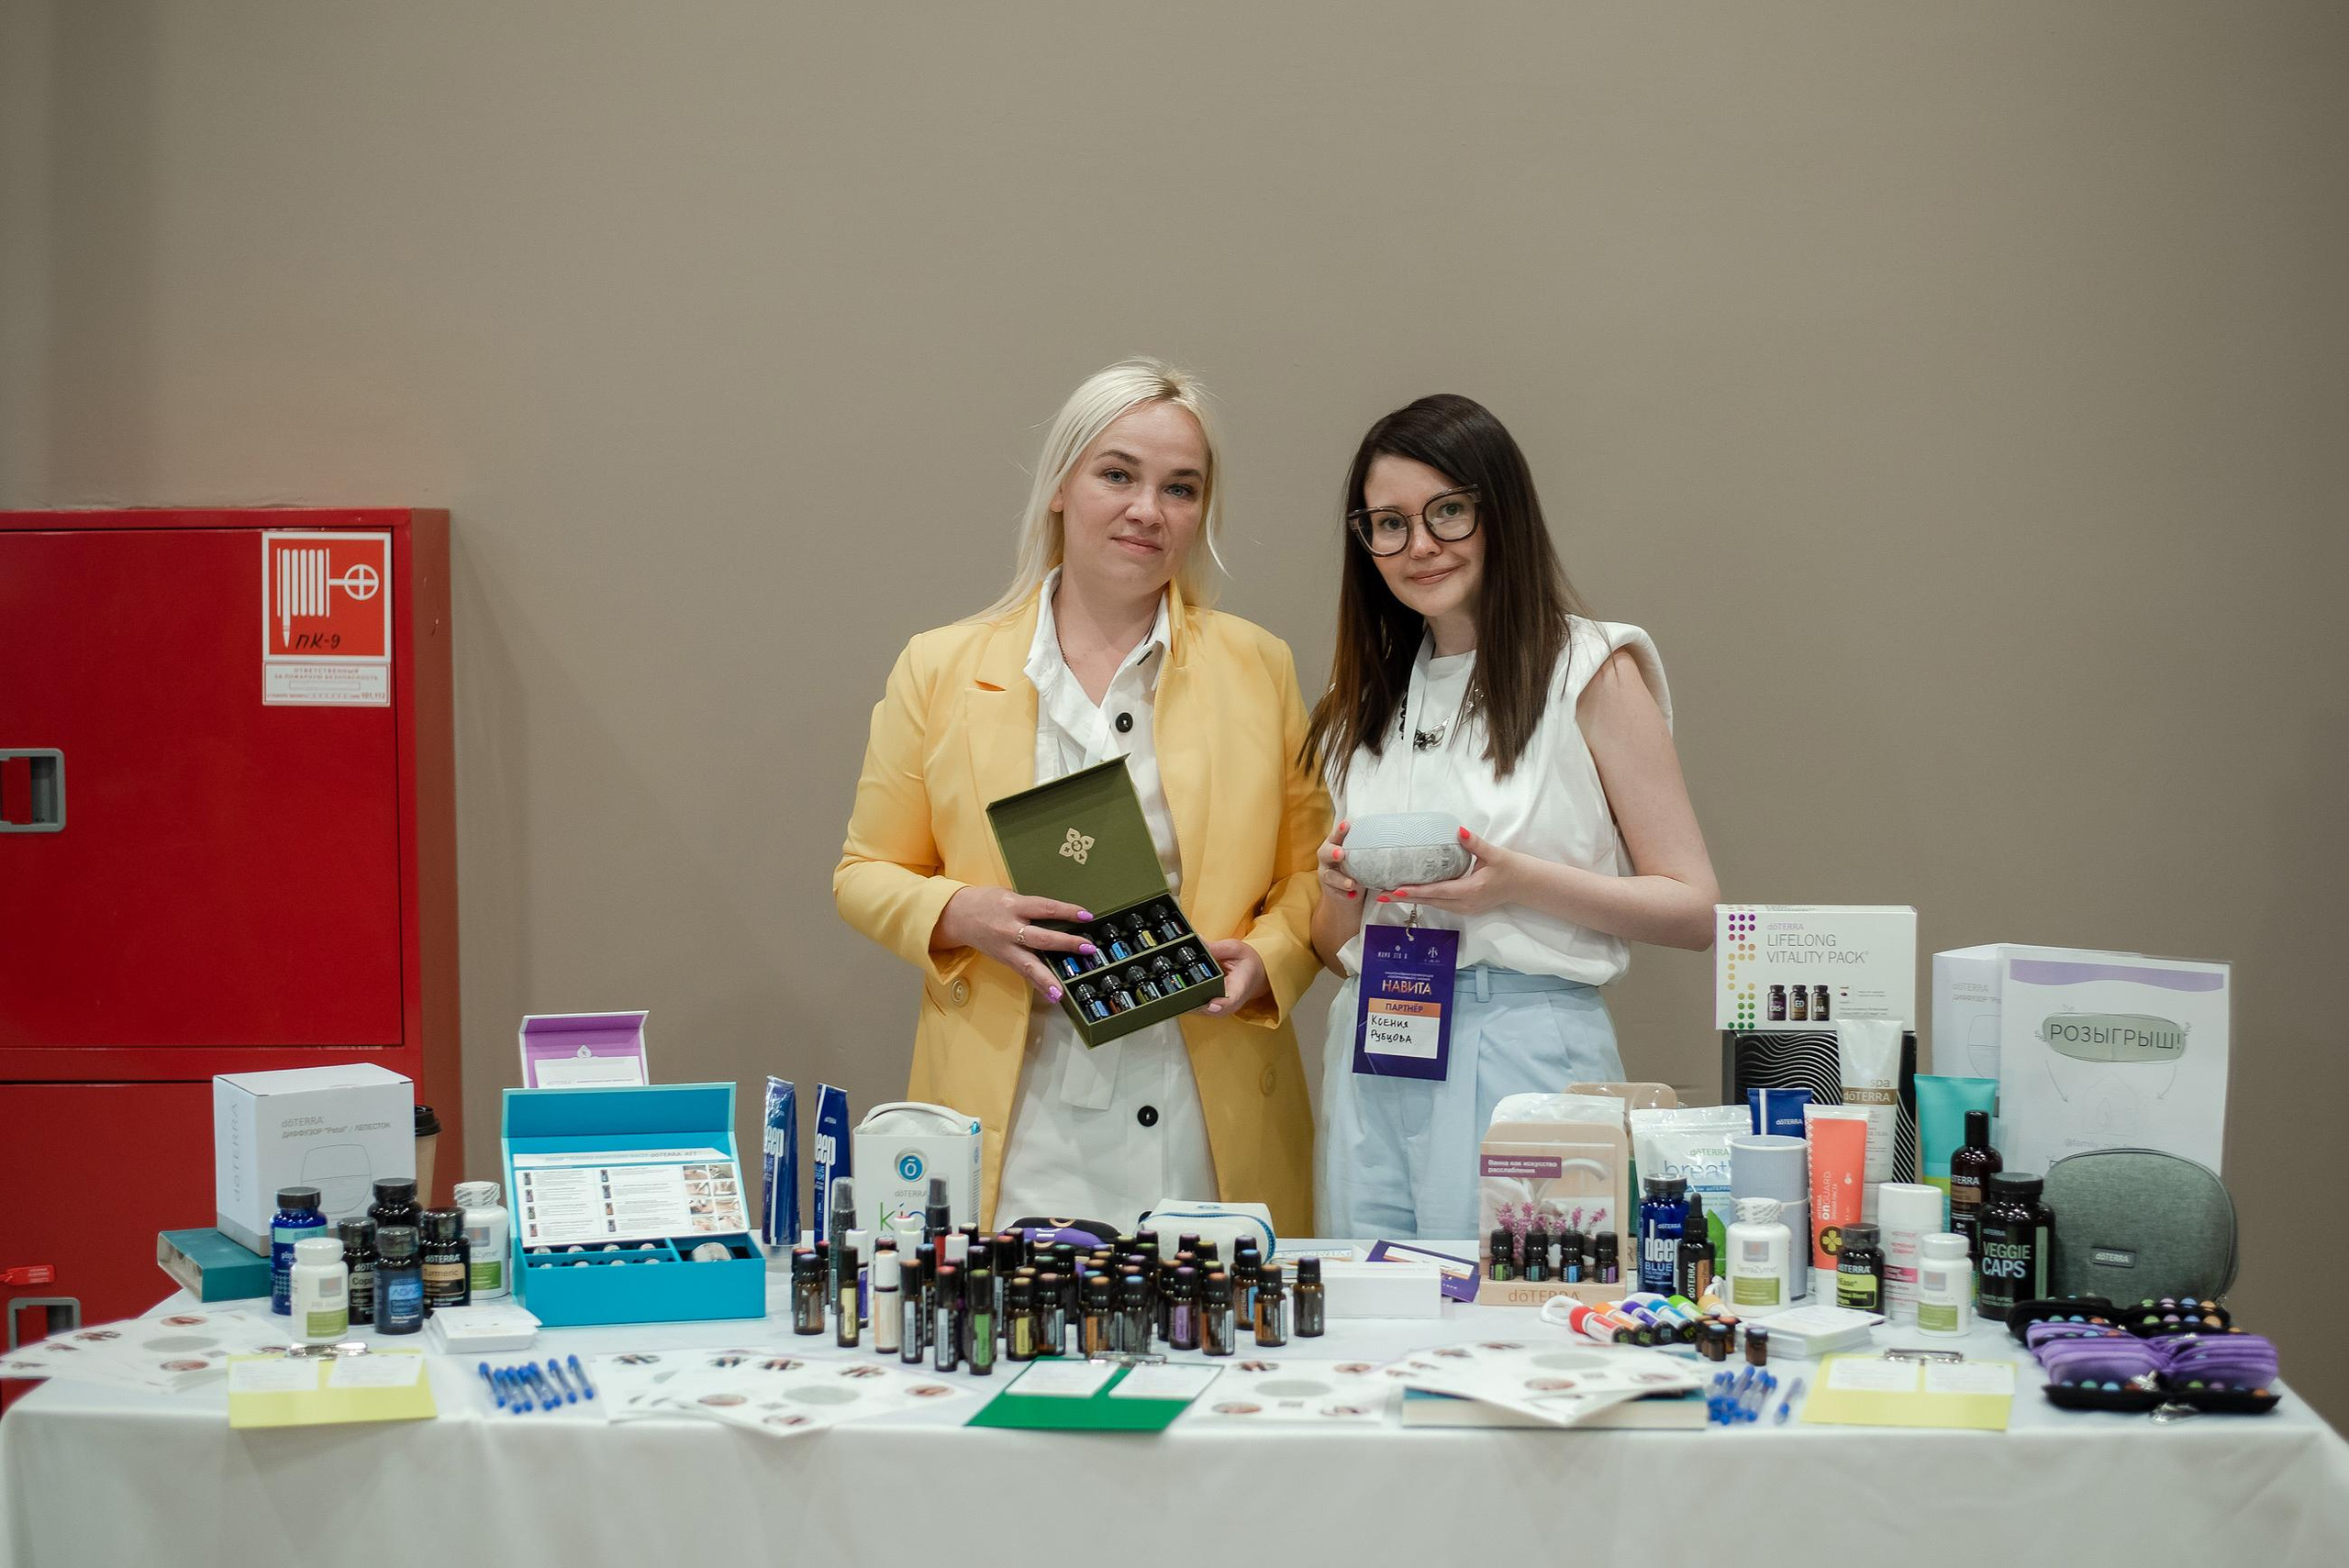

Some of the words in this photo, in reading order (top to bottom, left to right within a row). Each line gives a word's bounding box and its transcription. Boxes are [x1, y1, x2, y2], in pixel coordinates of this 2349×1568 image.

[295, 632, 340, 650] ПК-9
[1767, 933, 1836, 947] LIFELONG
[1766, 951, 1824, 964] VITALITY
[1382, 979, 1432, 995] НАВИТА
[2049, 1023, 2181, 1051] РОЗЫГРЫШ!
[1870, 1078, 1890, 1088] spa
[763, 1125, 785, 1158] eep
[815, 1133, 836, 1166] eep
[1982, 1241, 2032, 1260] VEGGIE
[1644, 1262, 1673, 1272] BLUE
[1982, 1256, 2026, 1279] CAPS
